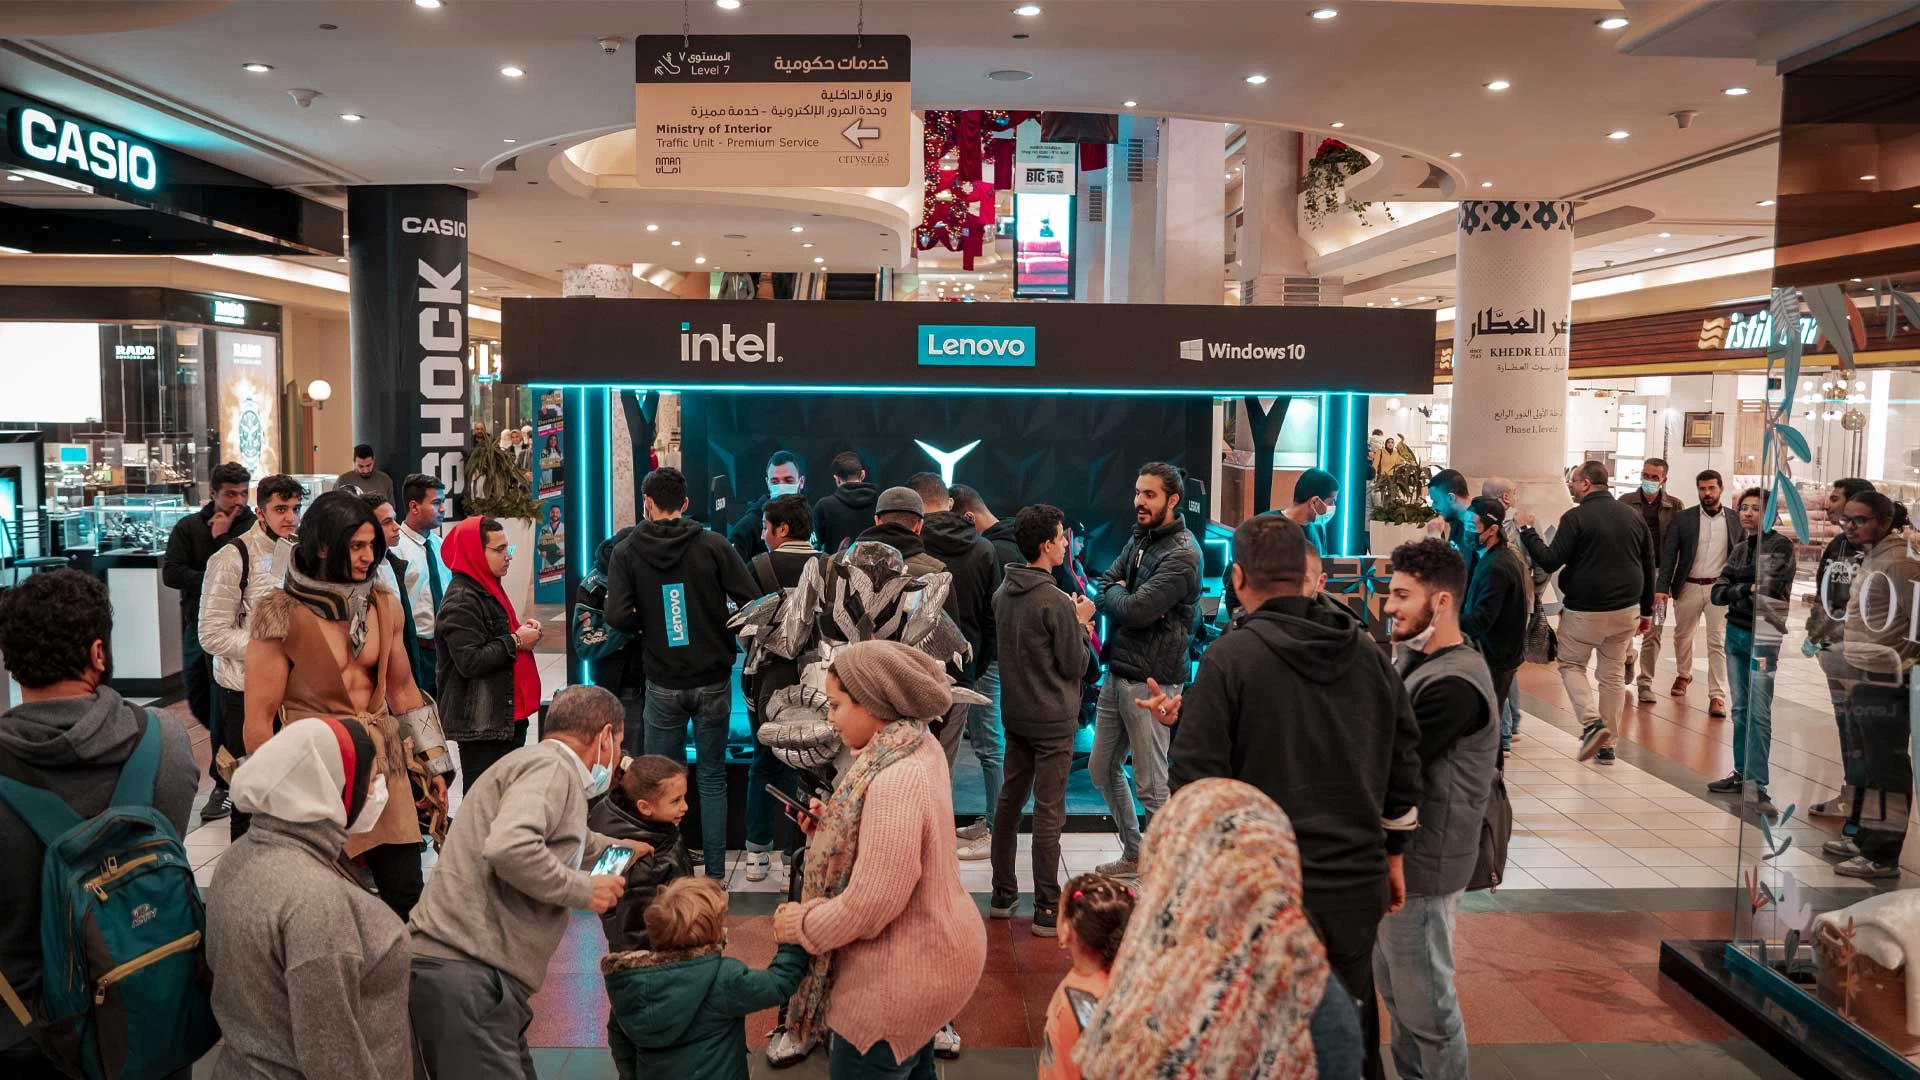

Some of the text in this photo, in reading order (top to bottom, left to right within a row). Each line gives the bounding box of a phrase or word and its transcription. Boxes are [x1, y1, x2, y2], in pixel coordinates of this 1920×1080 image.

[687, 51, 731, 63] المستوى
[691, 65, 730, 75] Level 7
[774, 56, 889, 73] خدمات حكومية
[820, 89, 893, 102] وزارة الداخلية
[690, 106, 726, 119] مميزة
[728, 106, 759, 117] خدمة
[827, 105, 857, 118] المرور
[858, 106, 887, 117] وحدة
[656, 124, 772, 135] Ministry of Interior
[21, 108, 157, 190] CASIO
[656, 138, 689, 148] Traffic
[692, 138, 715, 148] Unit
[727, 138, 775, 148] Premium
[779, 137, 820, 147] Service
[1026, 168, 1045, 182] BTC
[401, 216, 467, 239] CASIO
[928, 333, 1026, 357] Lenovo
[1207, 342, 1286, 360] Windows
[1490, 347, 1532, 358] KHEDR
[669, 588, 685, 642] Lenovo
